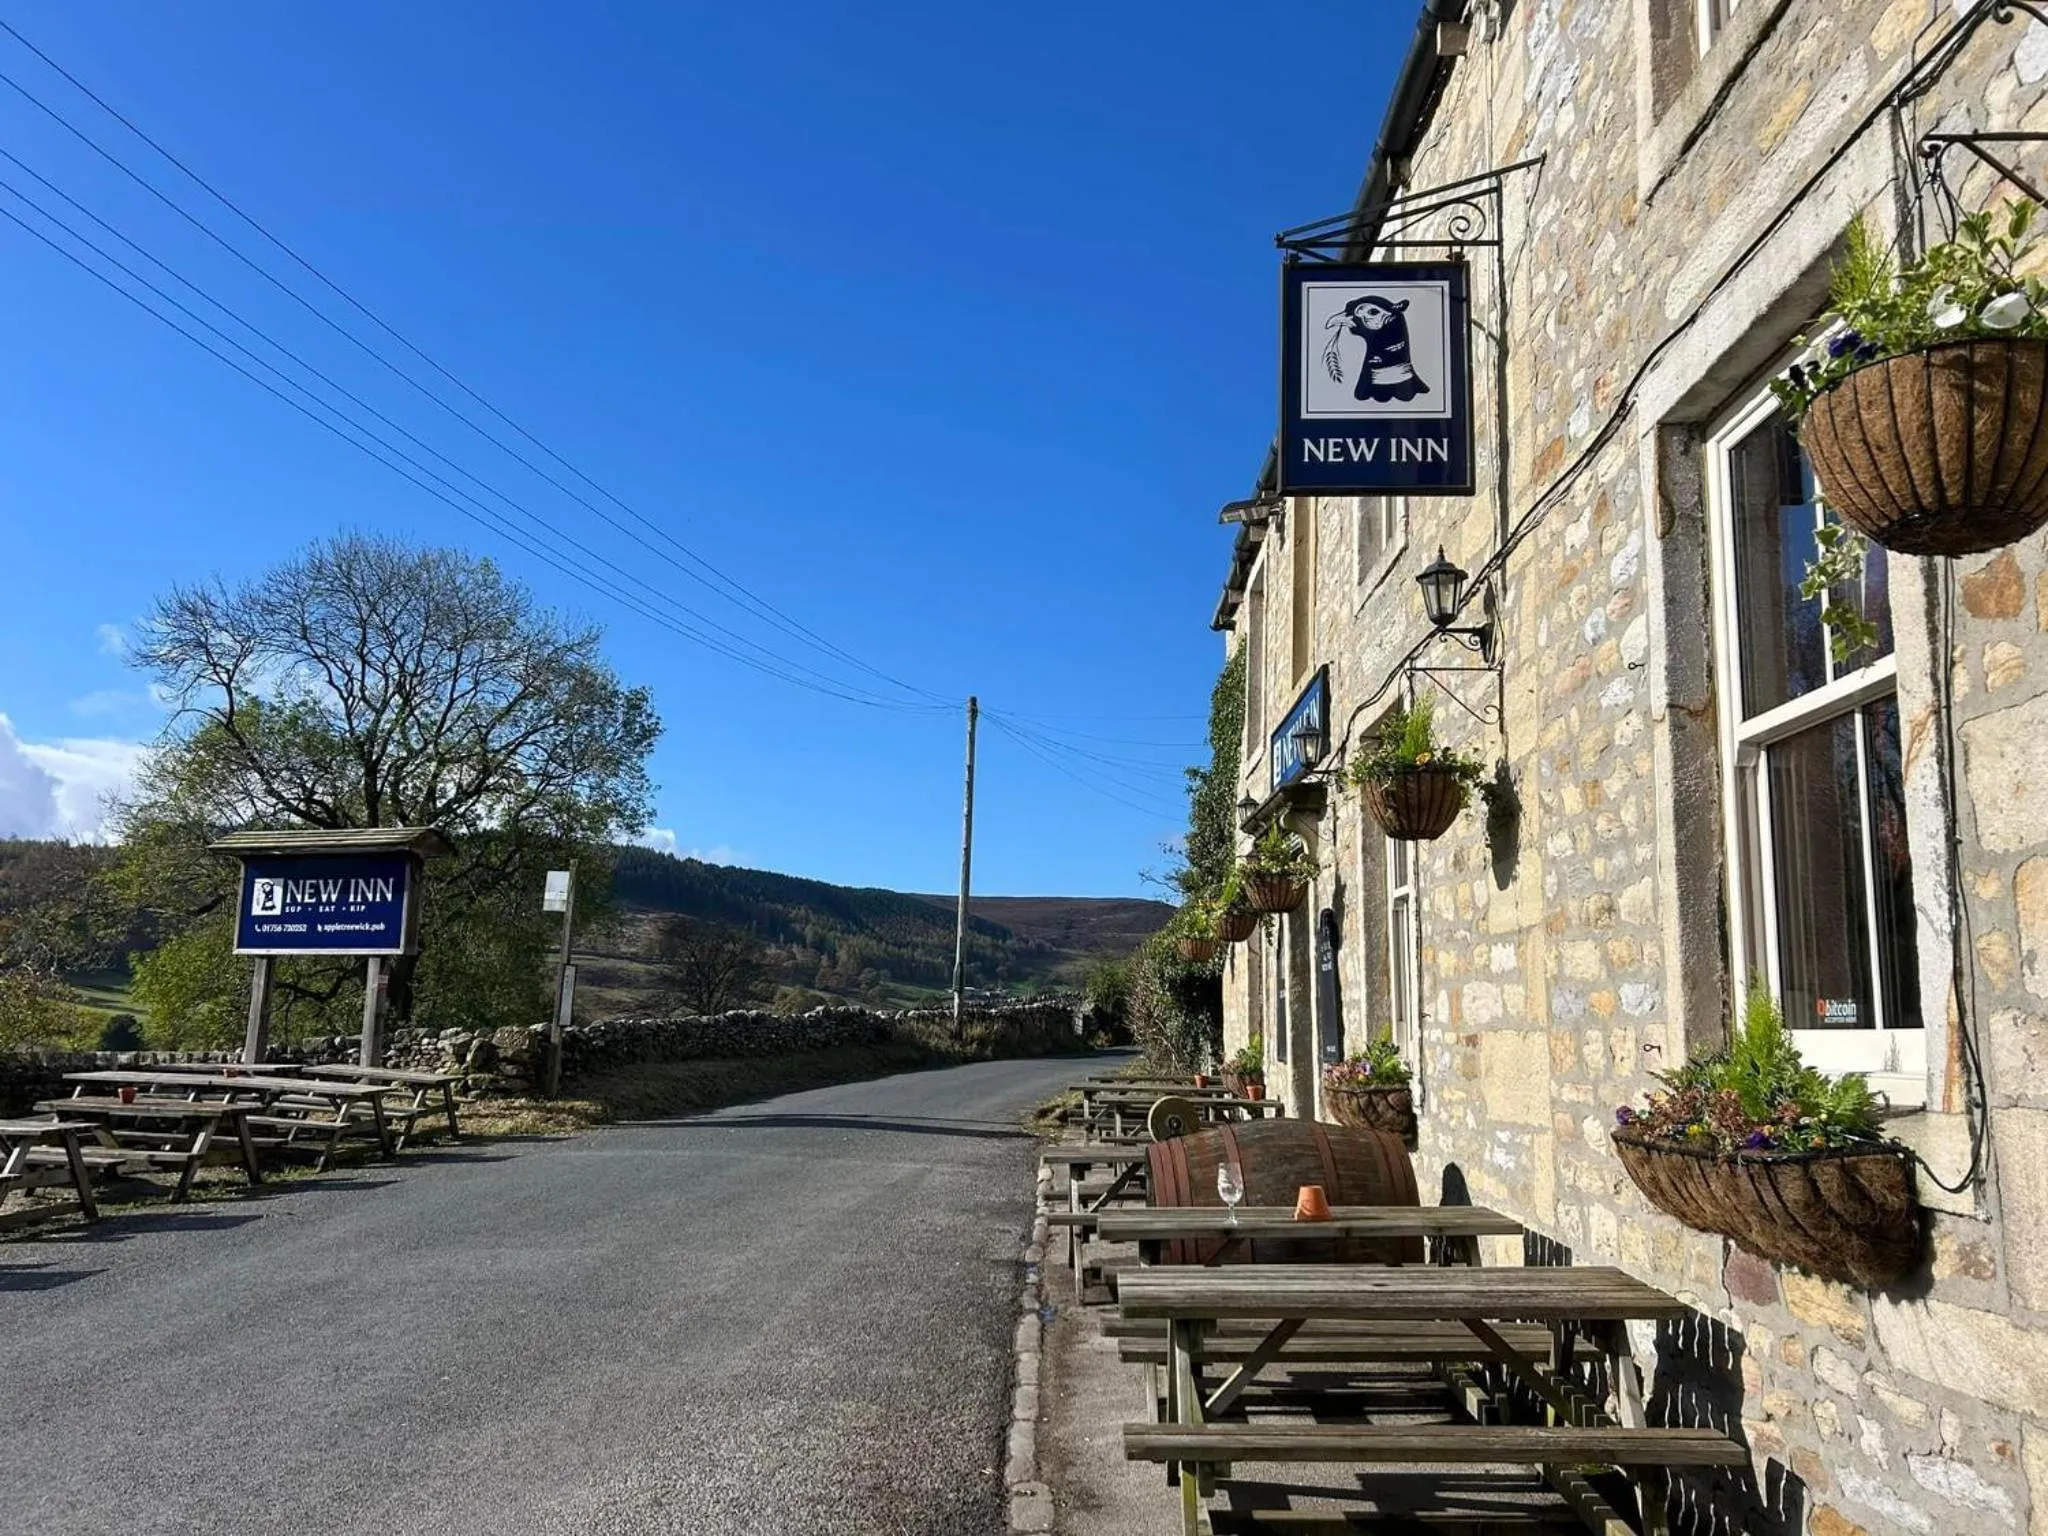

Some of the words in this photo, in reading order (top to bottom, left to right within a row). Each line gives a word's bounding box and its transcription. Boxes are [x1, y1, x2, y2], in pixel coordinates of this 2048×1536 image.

[1302, 437, 1380, 463] NEW
[1389, 437, 1449, 463] INN
[286, 877, 343, 904] NEW
[349, 877, 394, 903] INN
[285, 905, 302, 913] SUP
[319, 905, 336, 913] EAT
[350, 905, 366, 913] KIP
[1825, 998, 1857, 1017] bitcoin
